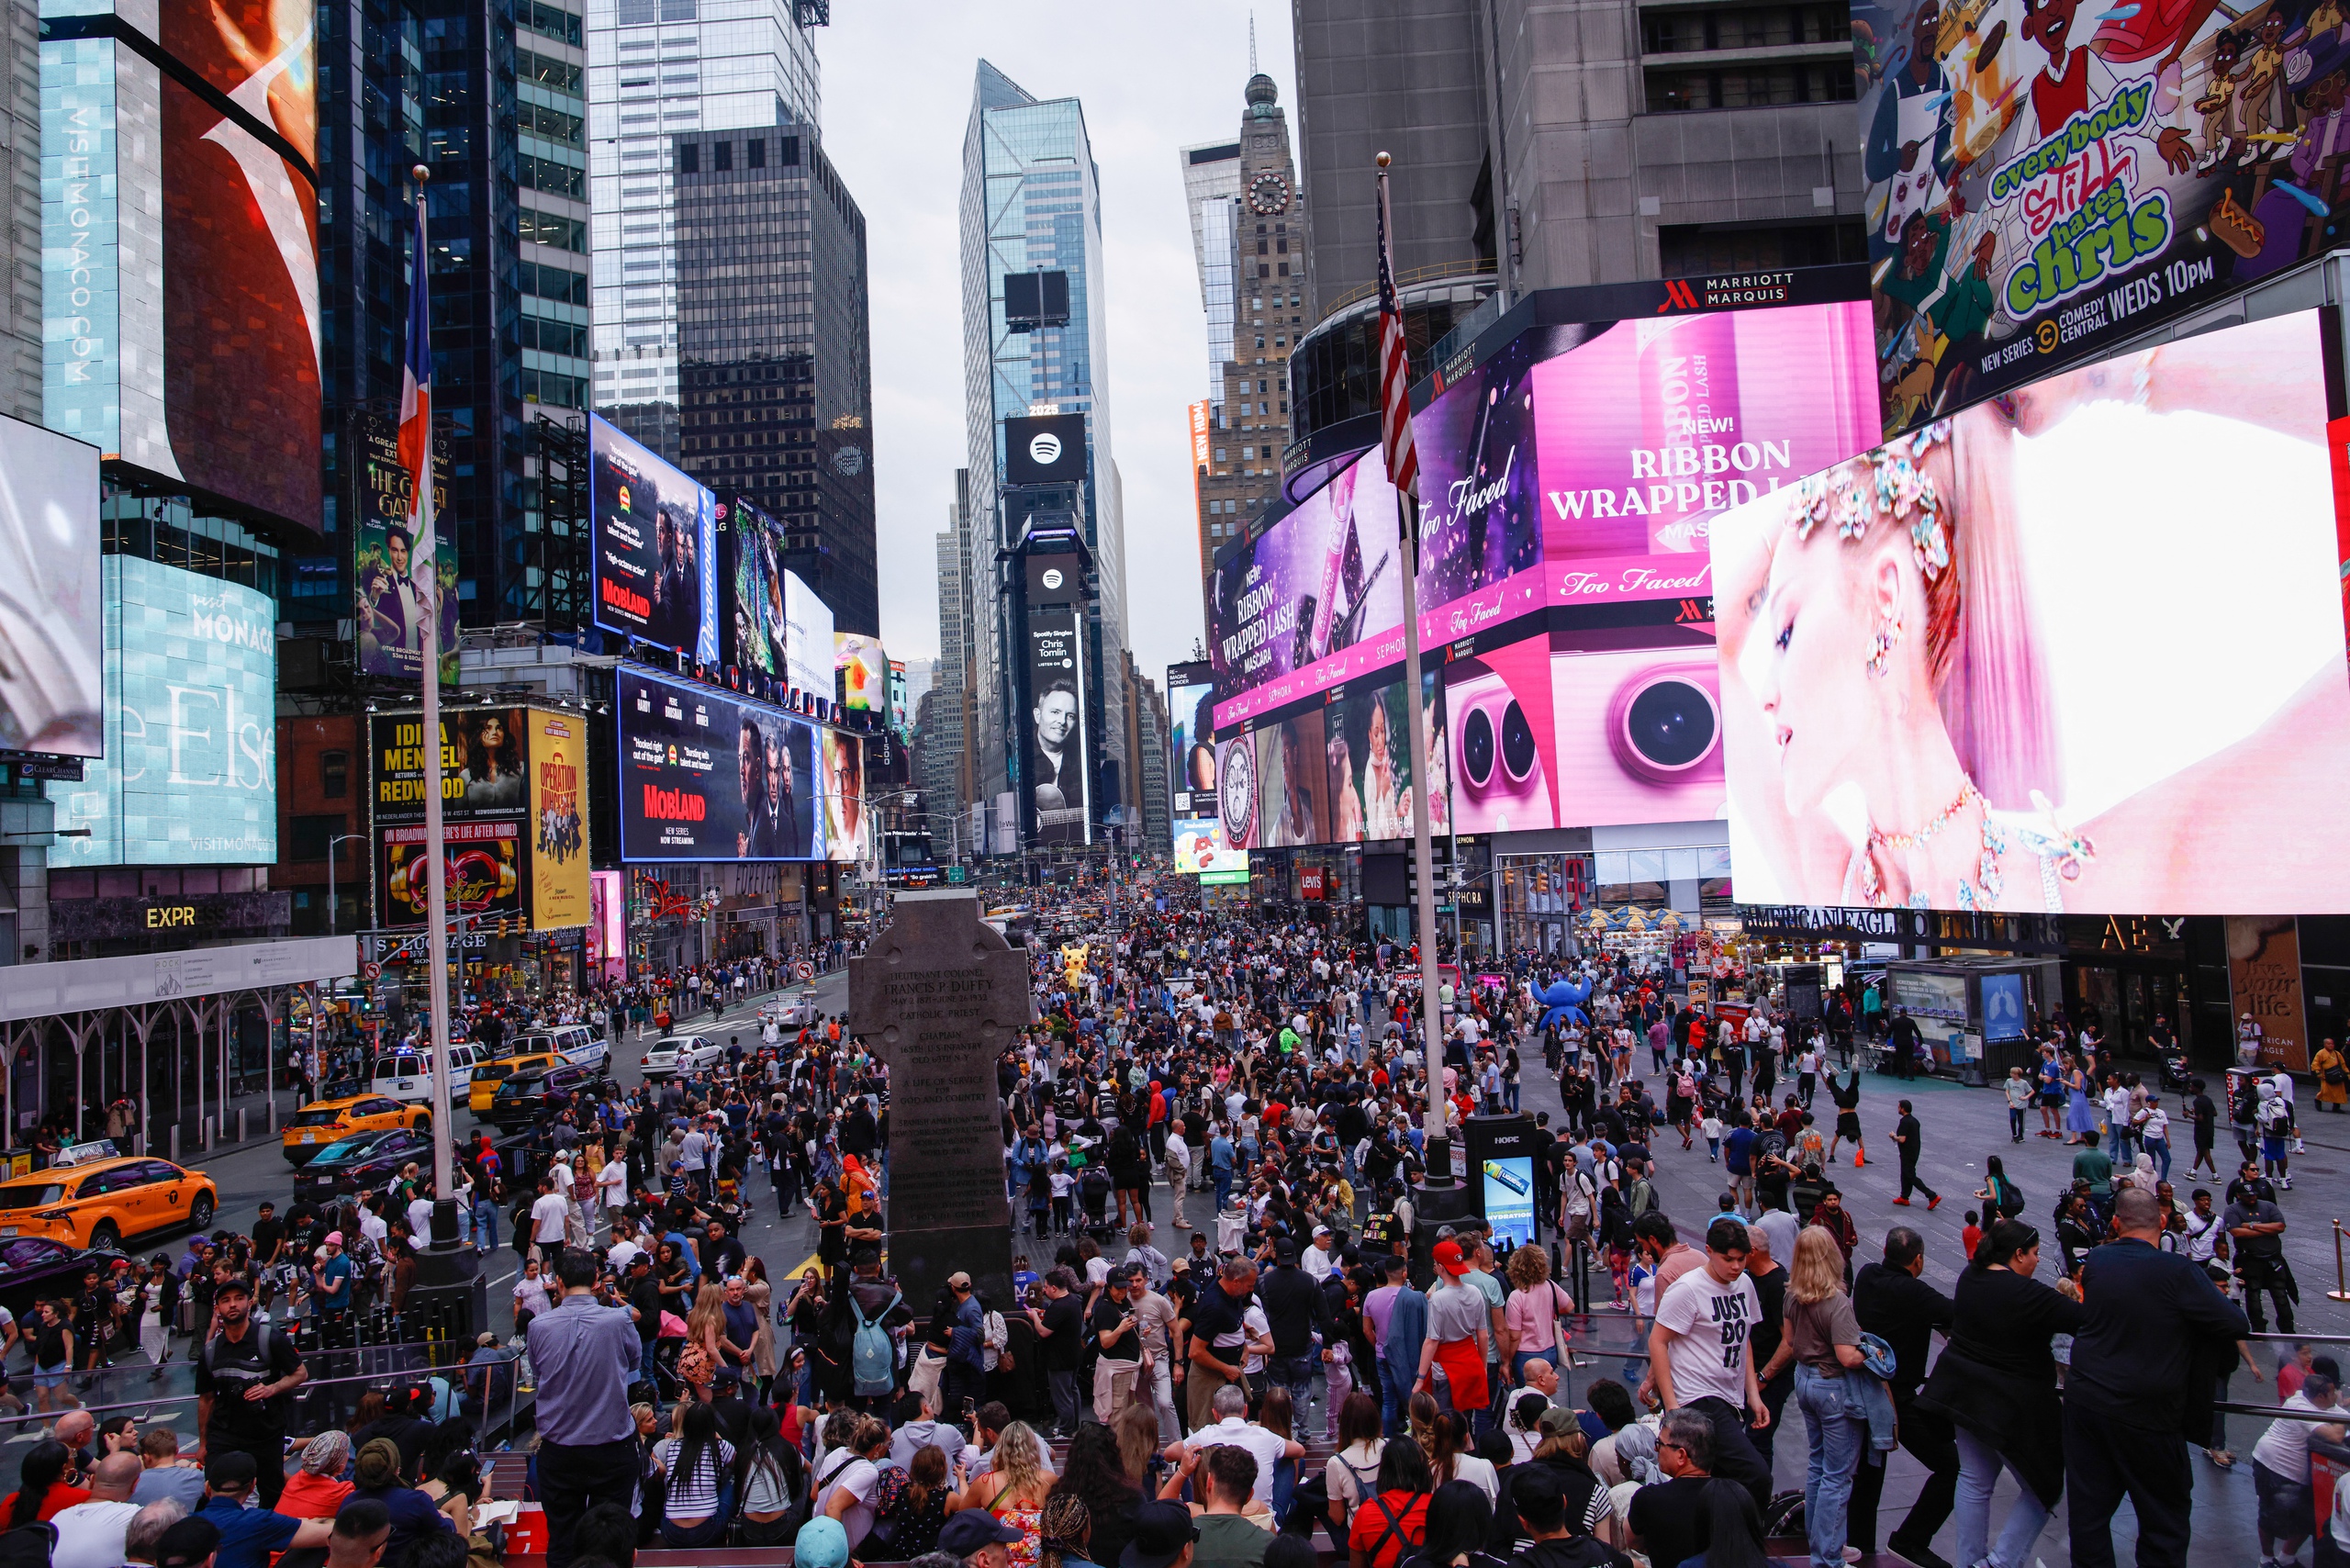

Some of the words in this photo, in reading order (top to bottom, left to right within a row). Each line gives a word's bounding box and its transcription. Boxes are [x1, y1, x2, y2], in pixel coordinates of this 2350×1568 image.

[1990, 81, 2153, 200] everybody
[2051, 178, 2124, 250] hates
[66, 106, 92, 383] VISITMONACO.COM
[2008, 198, 2165, 313] chris
[1706, 273, 1794, 290] MARRIOTT
[2108, 273, 2162, 322] WEDS
[2165, 256, 2214, 297] 10PM
[1707, 288, 1785, 306] MARQUIS
[2058, 296, 2106, 330] COMEDY
[2060, 314, 2109, 344] CENTRAL
[1446, 342, 1476, 374] MARRIOTT
[1981, 354, 2001, 375] NEW
[2002, 336, 2034, 363] SERIES
[1446, 359, 1473, 386] MARQUIS
[1029, 404, 1059, 416] 2025
[1682, 417, 1734, 435] NEW!
[375, 438, 397, 450] GREAT
[1195, 434, 1208, 462] NEW
[1284, 437, 1312, 461] MARRIOTT
[1284, 452, 1309, 476] MARQUIS
[1630, 439, 1791, 479] RIBBON
[368, 467, 397, 495] THE
[399, 476, 448, 510] GAT
[1418, 500, 1441, 541] Too
[1446, 444, 1516, 526] Faced
[1548, 477, 1758, 521] WRAPPED
[395, 521, 408, 529] NEW
[1246, 564, 1262, 588] NEW!
[1560, 572, 1609, 596] Too
[1618, 562, 1711, 594] Faced
[193, 590, 231, 611] visit
[1237, 578, 1273, 625] RIBBON
[1318, 563, 1332, 629] RIBBON
[1450, 610, 1467, 633] Too
[1470, 591, 1505, 624] Faced
[193, 609, 274, 657] MONACO
[1053, 630, 1072, 638] Singles
[1223, 618, 1266, 663] WRAPPED
[1268, 599, 1295, 641] LASH
[396, 647, 421, 655] BROADWAY
[1038, 647, 1067, 657] Tomlin
[1042, 639, 1063, 649] Chris
[1376, 637, 1407, 660] SEPHOR
[1454, 637, 1475, 650] MARRIOTT
[1454, 646, 1473, 659] MARQUIS
[1244, 647, 1272, 674] MASCARA
[1315, 668, 1326, 685] Too
[1327, 657, 1348, 681] Faced
[1269, 684, 1292, 703] SEPHORA
[396, 722, 448, 746] IDIA
[385, 745, 460, 771] MENEL
[395, 771, 417, 779] RETURNS
[541, 761, 576, 791] OPERATION
[380, 778, 464, 802] REDWOD
[475, 807, 526, 815] REDWOODMUSICAL.COM
[385, 830, 395, 842] ON
[396, 827, 428, 842] BROADWA
[461, 825, 474, 838] LIFE
[474, 824, 494, 838] AFTER
[495, 823, 518, 837] ROMEO
[660, 836, 670, 845] NOW
[671, 836, 695, 845] STREAMING
[665, 827, 676, 835] NEW
[677, 827, 689, 835] SERIES
[735, 863, 778, 896] FOREVER
[1565, 858, 1586, 912] T
[1448, 890, 1483, 904] SEPHORA
[552, 928, 581, 939] LUGGAGE
[748, 918, 764, 933] FOREVER
[1744, 907, 1836, 930] AMERICAN
[1842, 908, 1906, 935] EAGLE
[1913, 913, 2065, 946] OUTFITTERS
[2101, 914, 2149, 952] AE
[155, 958, 180, 969] ROCK
[890, 970, 941, 980] LIEUTENANT
[944, 969, 985, 978] COLONEL
[884, 981, 935, 995] FRANCIS
[951, 980, 994, 992] DUFFY
[2236, 977, 2297, 996] your
[970, 993, 988, 1002] 1932
[2250, 994, 2292, 1017] life
[900, 1010, 944, 1020] CATHOLIC
[948, 1008, 980, 1017] PRIEST
[919, 1031, 962, 1041] CHAPLAIN
[944, 1042, 982, 1051] INFANTRY
[912, 1056, 929, 1064] OLD
[912, 1078, 930, 1087] LIFE
[933, 1077, 945, 1086] OF
[948, 1076, 984, 1085] SERVICE
[900, 1097, 921, 1105] GOD
[923, 1095, 943, 1103] AND
[945, 1092, 987, 1102] COUNTRY
[899, 1119, 929, 1127] SPANISH
[931, 1115, 971, 1125] AMERICAN
[973, 1114, 990, 1123] WAR
[890, 1130, 907, 1138] NEW
[933, 1126, 970, 1136] NATIONAL
[972, 1125, 1001, 1133] GUARD
[911, 1137, 946, 1146] MEXICAN
[948, 1137, 979, 1145] BORDER
[1494, 1136, 1519, 1144] HOPE
[920, 1148, 948, 1156] WORLD
[890, 1170, 945, 1181] DISTINGUISHED
[947, 1169, 976, 1178] SERVICE
[979, 1167, 1003, 1175] CROSS
[947, 1179, 977, 1188] SERVICE
[979, 1177, 1003, 1186] MEDAL
[1487, 1212, 1532, 1221] HYDRATION
[1711, 1292, 1749, 1322] JUST
[1720, 1318, 1746, 1345] DO
[1723, 1344, 1740, 1368] IT.
